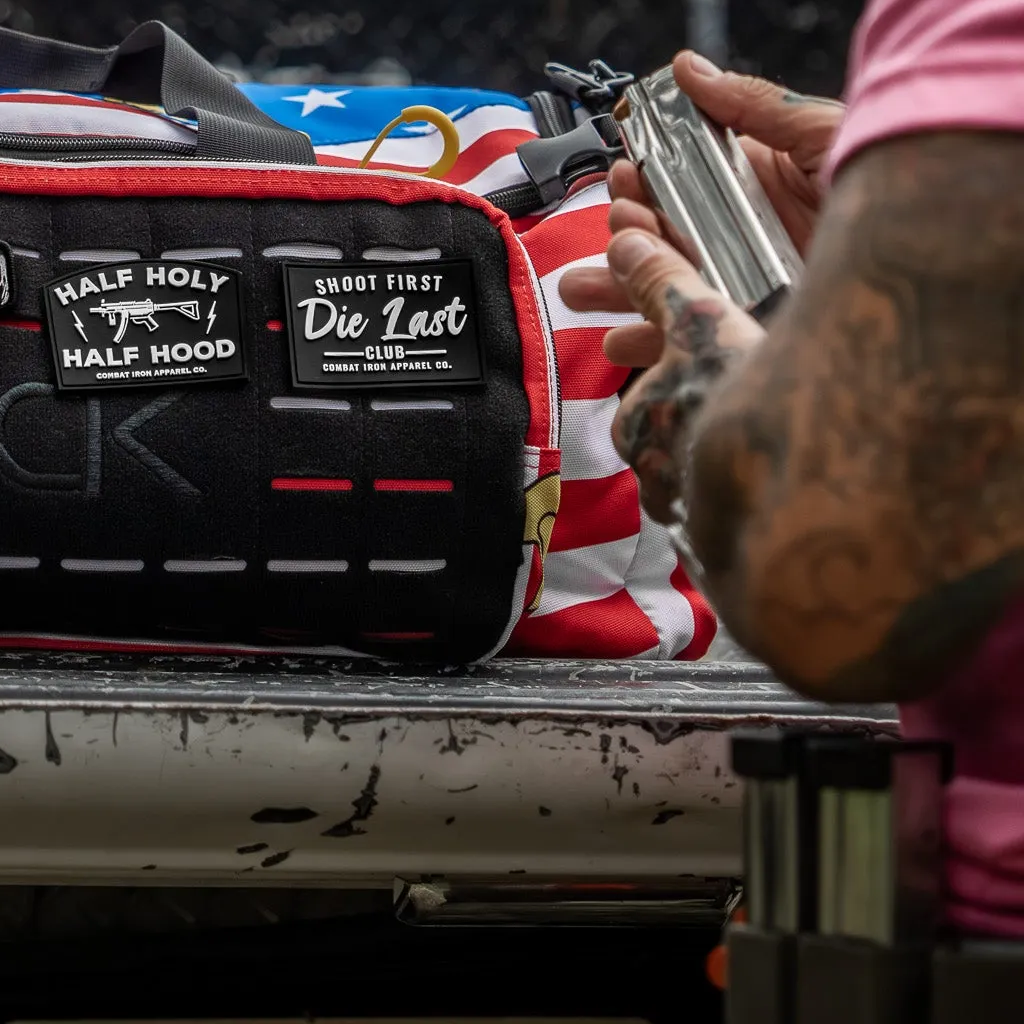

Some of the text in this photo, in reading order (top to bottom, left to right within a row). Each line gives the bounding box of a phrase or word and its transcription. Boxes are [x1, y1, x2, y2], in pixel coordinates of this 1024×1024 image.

[54, 267, 229, 306] HALF HOLY
[315, 274, 443, 295] SHOOT FIRST
[297, 296, 467, 340] Die Last
[63, 339, 236, 368] HALF HOOD
[365, 345, 405, 360] CLUB
[96, 371, 129, 380] COMBAT
[131, 370, 152, 378] IRON
[154, 367, 191, 377] APPAREL
[323, 361, 452, 372] COMBAT IRON APPAREL CO.
